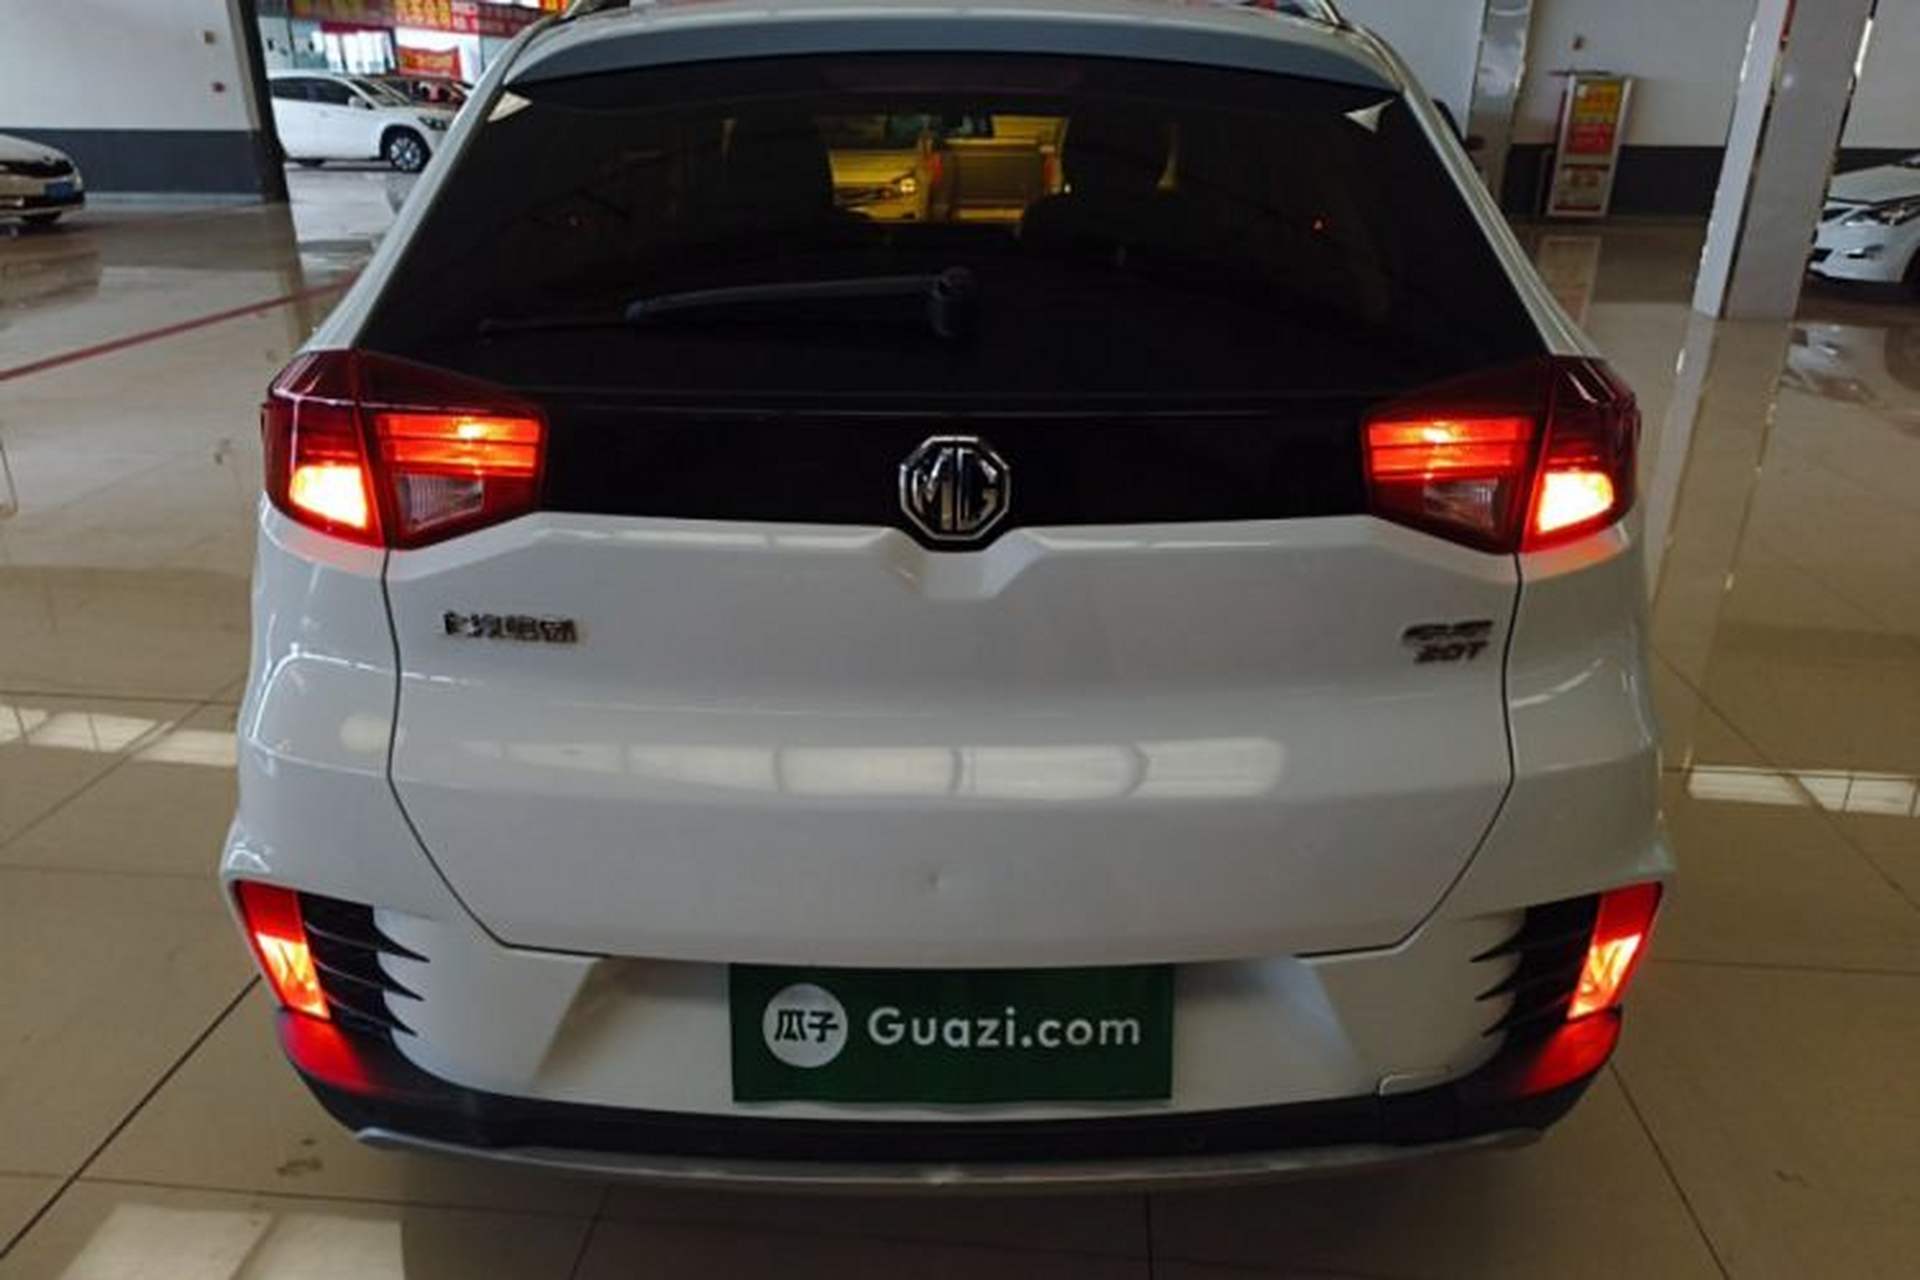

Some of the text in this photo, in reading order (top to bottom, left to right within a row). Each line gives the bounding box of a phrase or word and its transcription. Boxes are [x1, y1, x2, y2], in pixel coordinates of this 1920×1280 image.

[909, 446, 1000, 532] MG
[773, 1006, 1141, 1048] 瓜子 Guazi.com
